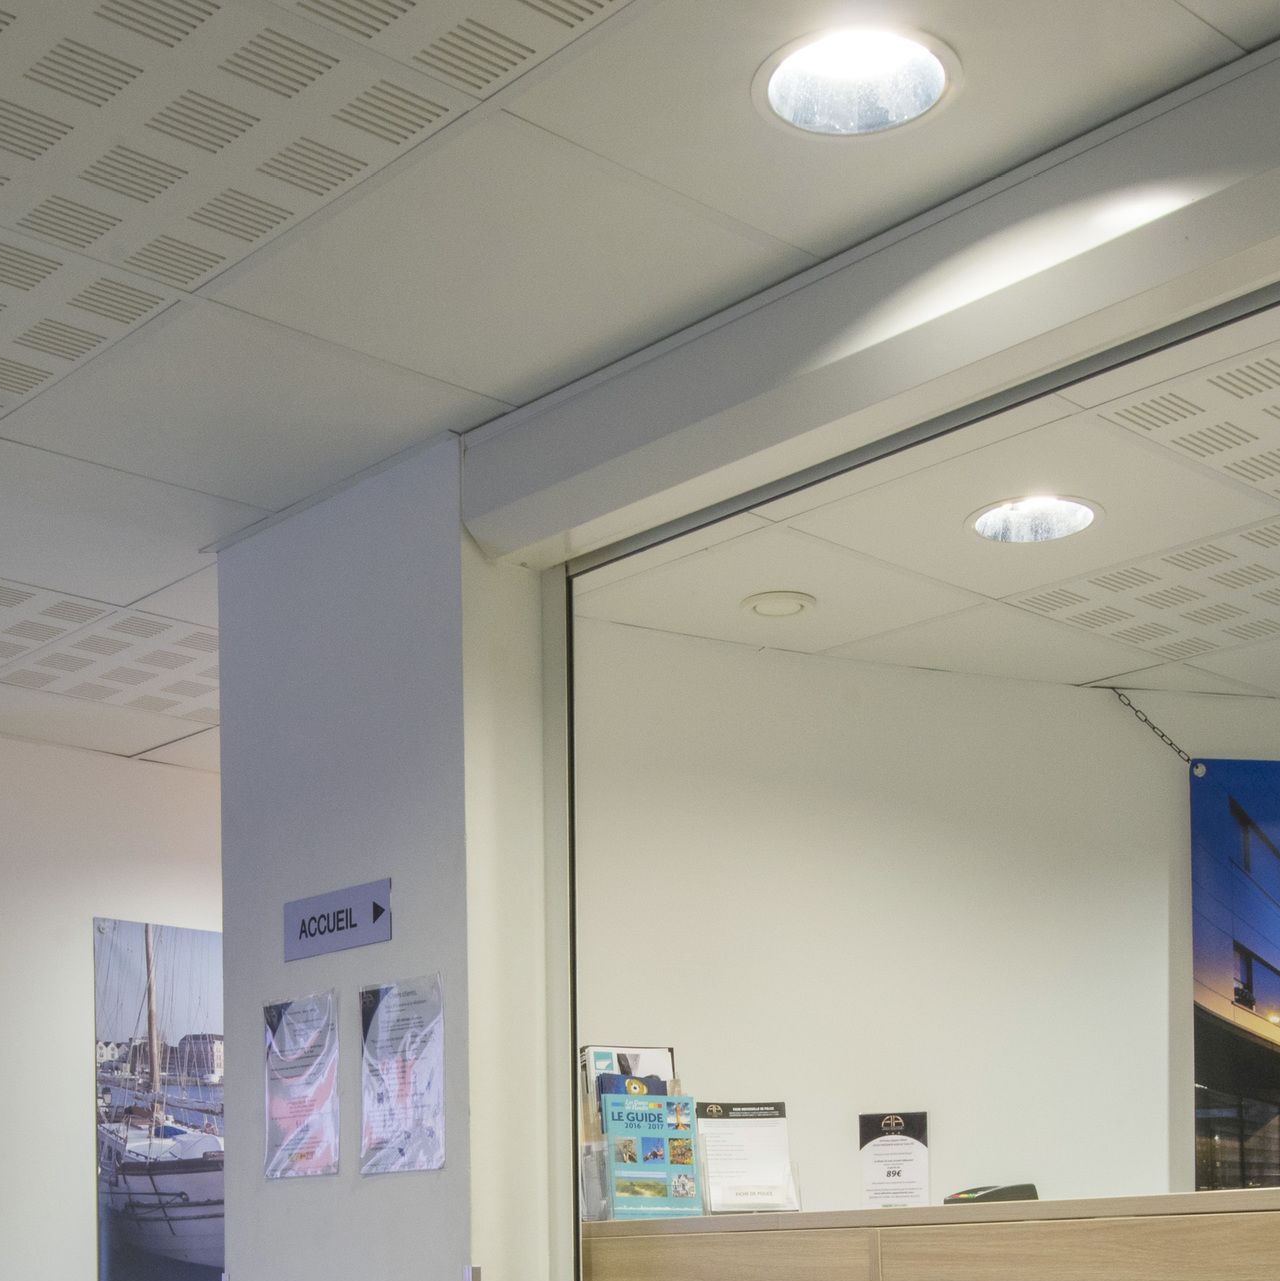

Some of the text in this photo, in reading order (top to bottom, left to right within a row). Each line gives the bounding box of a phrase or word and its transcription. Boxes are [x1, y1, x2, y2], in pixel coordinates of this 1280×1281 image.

[298, 907, 358, 940] ACCUEIL
[611, 1111, 664, 1123] LE GUIDE
[886, 1169, 902, 1177] 89€
